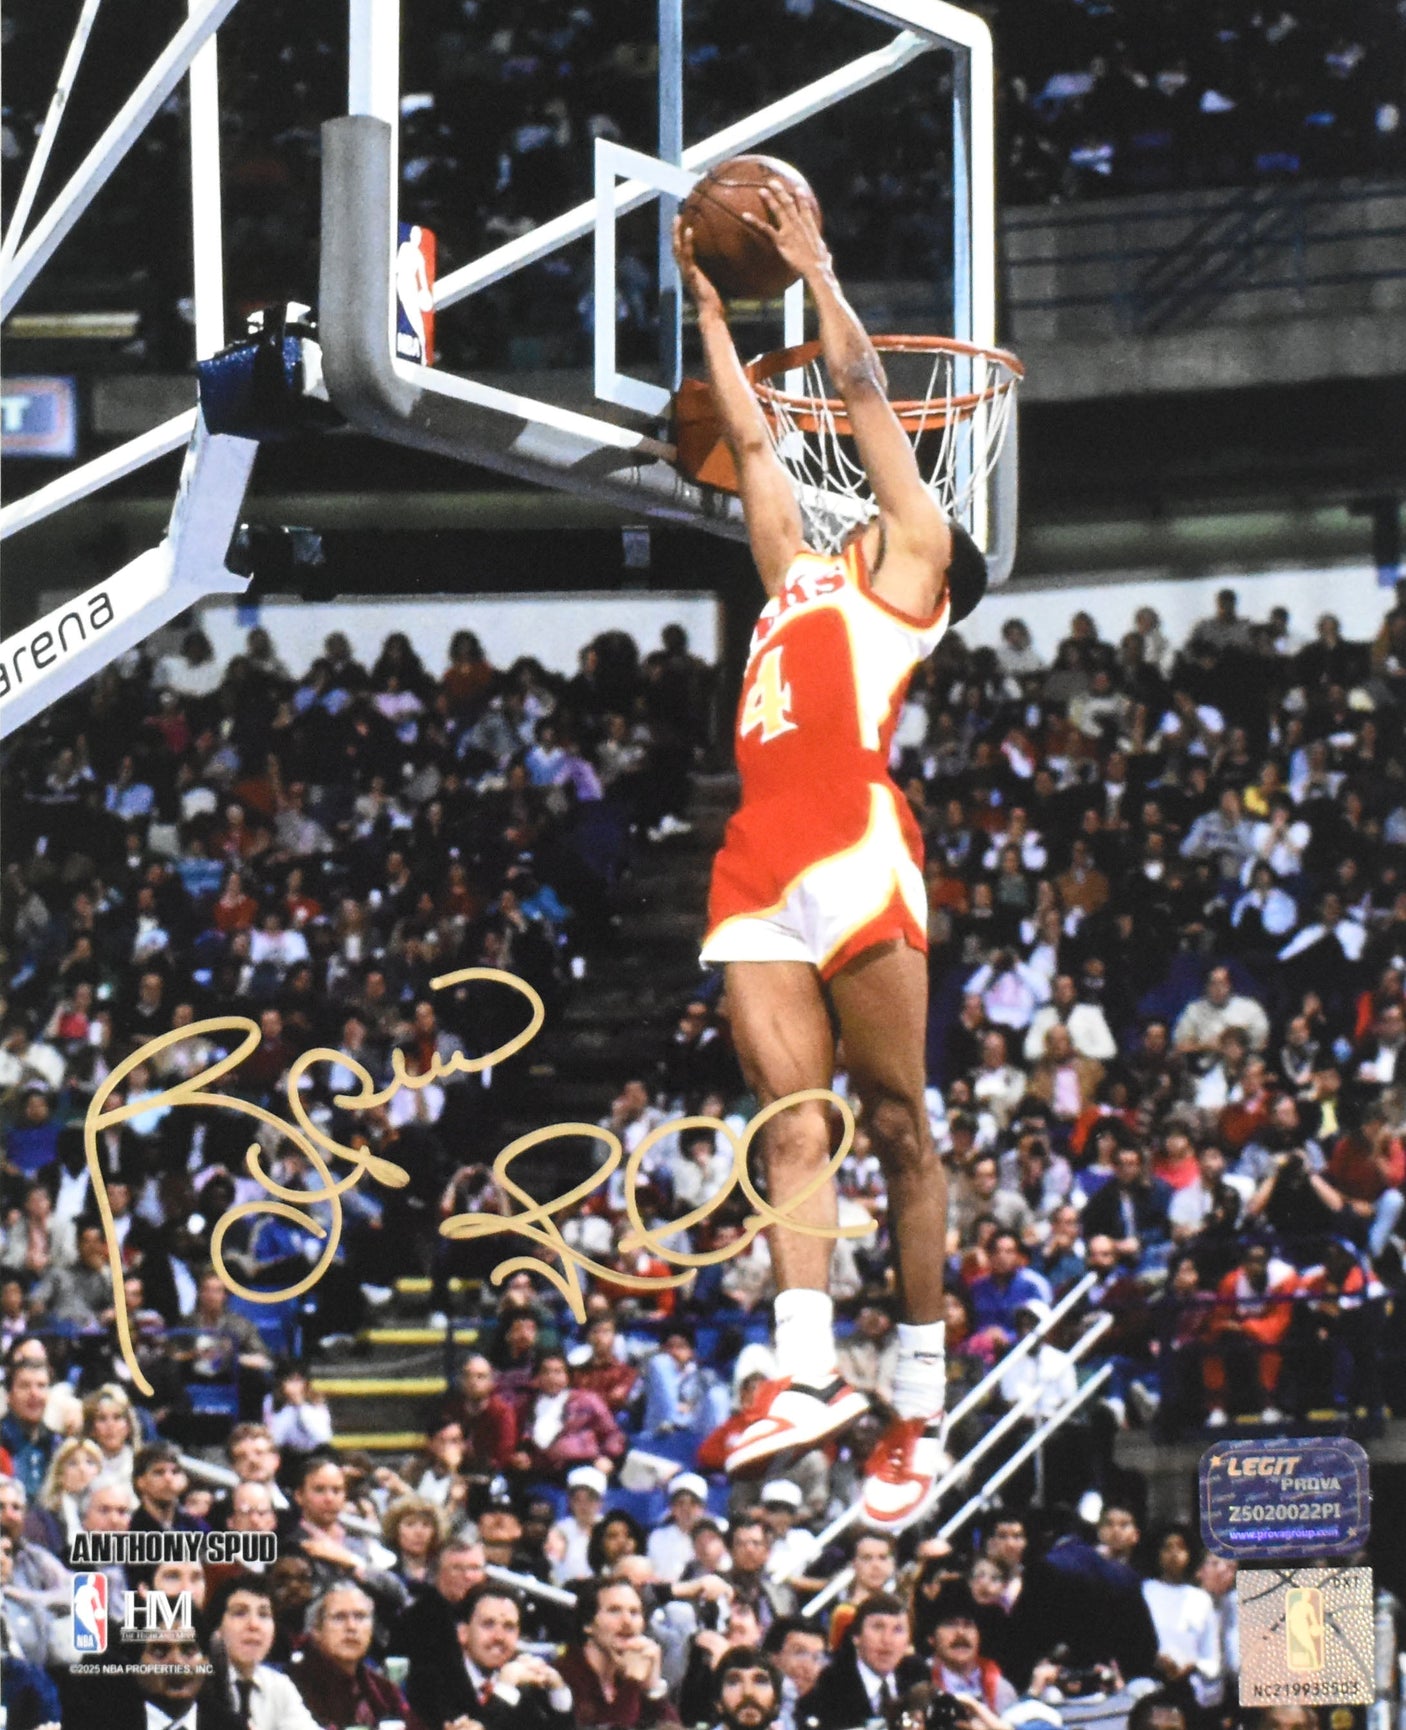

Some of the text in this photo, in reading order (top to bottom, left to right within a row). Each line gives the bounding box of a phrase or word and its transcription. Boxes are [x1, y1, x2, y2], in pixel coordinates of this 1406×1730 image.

[740, 645, 798, 744] 4
[1227, 1456, 1301, 1477] LEGIT
[1281, 1477, 1341, 1491] PROVA
[1229, 1502, 1341, 1522] Z5020022PI
